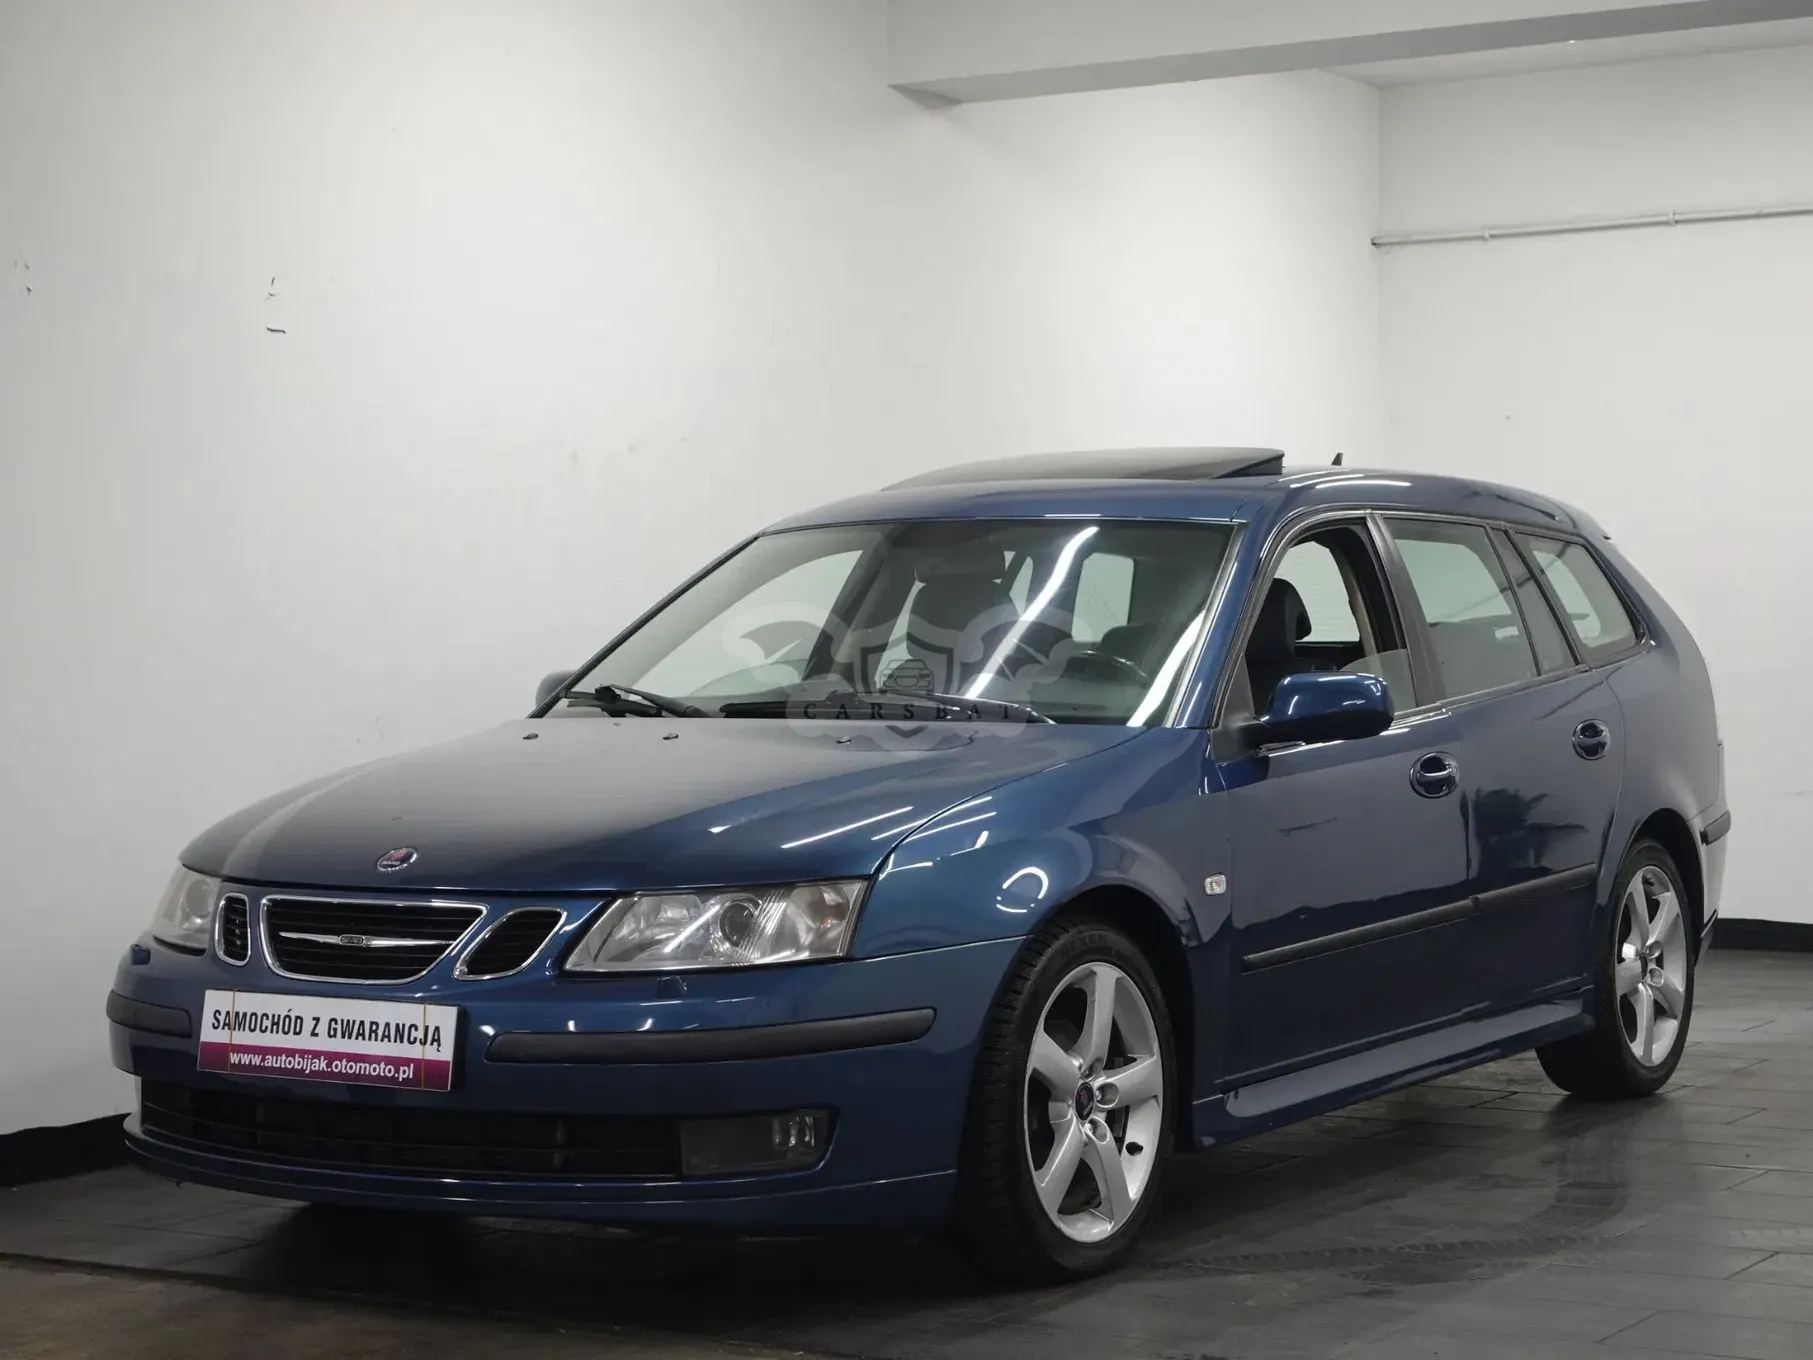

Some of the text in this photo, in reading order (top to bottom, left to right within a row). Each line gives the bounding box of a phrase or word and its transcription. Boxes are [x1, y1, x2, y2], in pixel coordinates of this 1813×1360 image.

[211, 1008, 442, 1052] SAMOCHÓD Z GWARANCJĄ
[230, 1052, 414, 1081] www.autobijak.otomoto.pl
